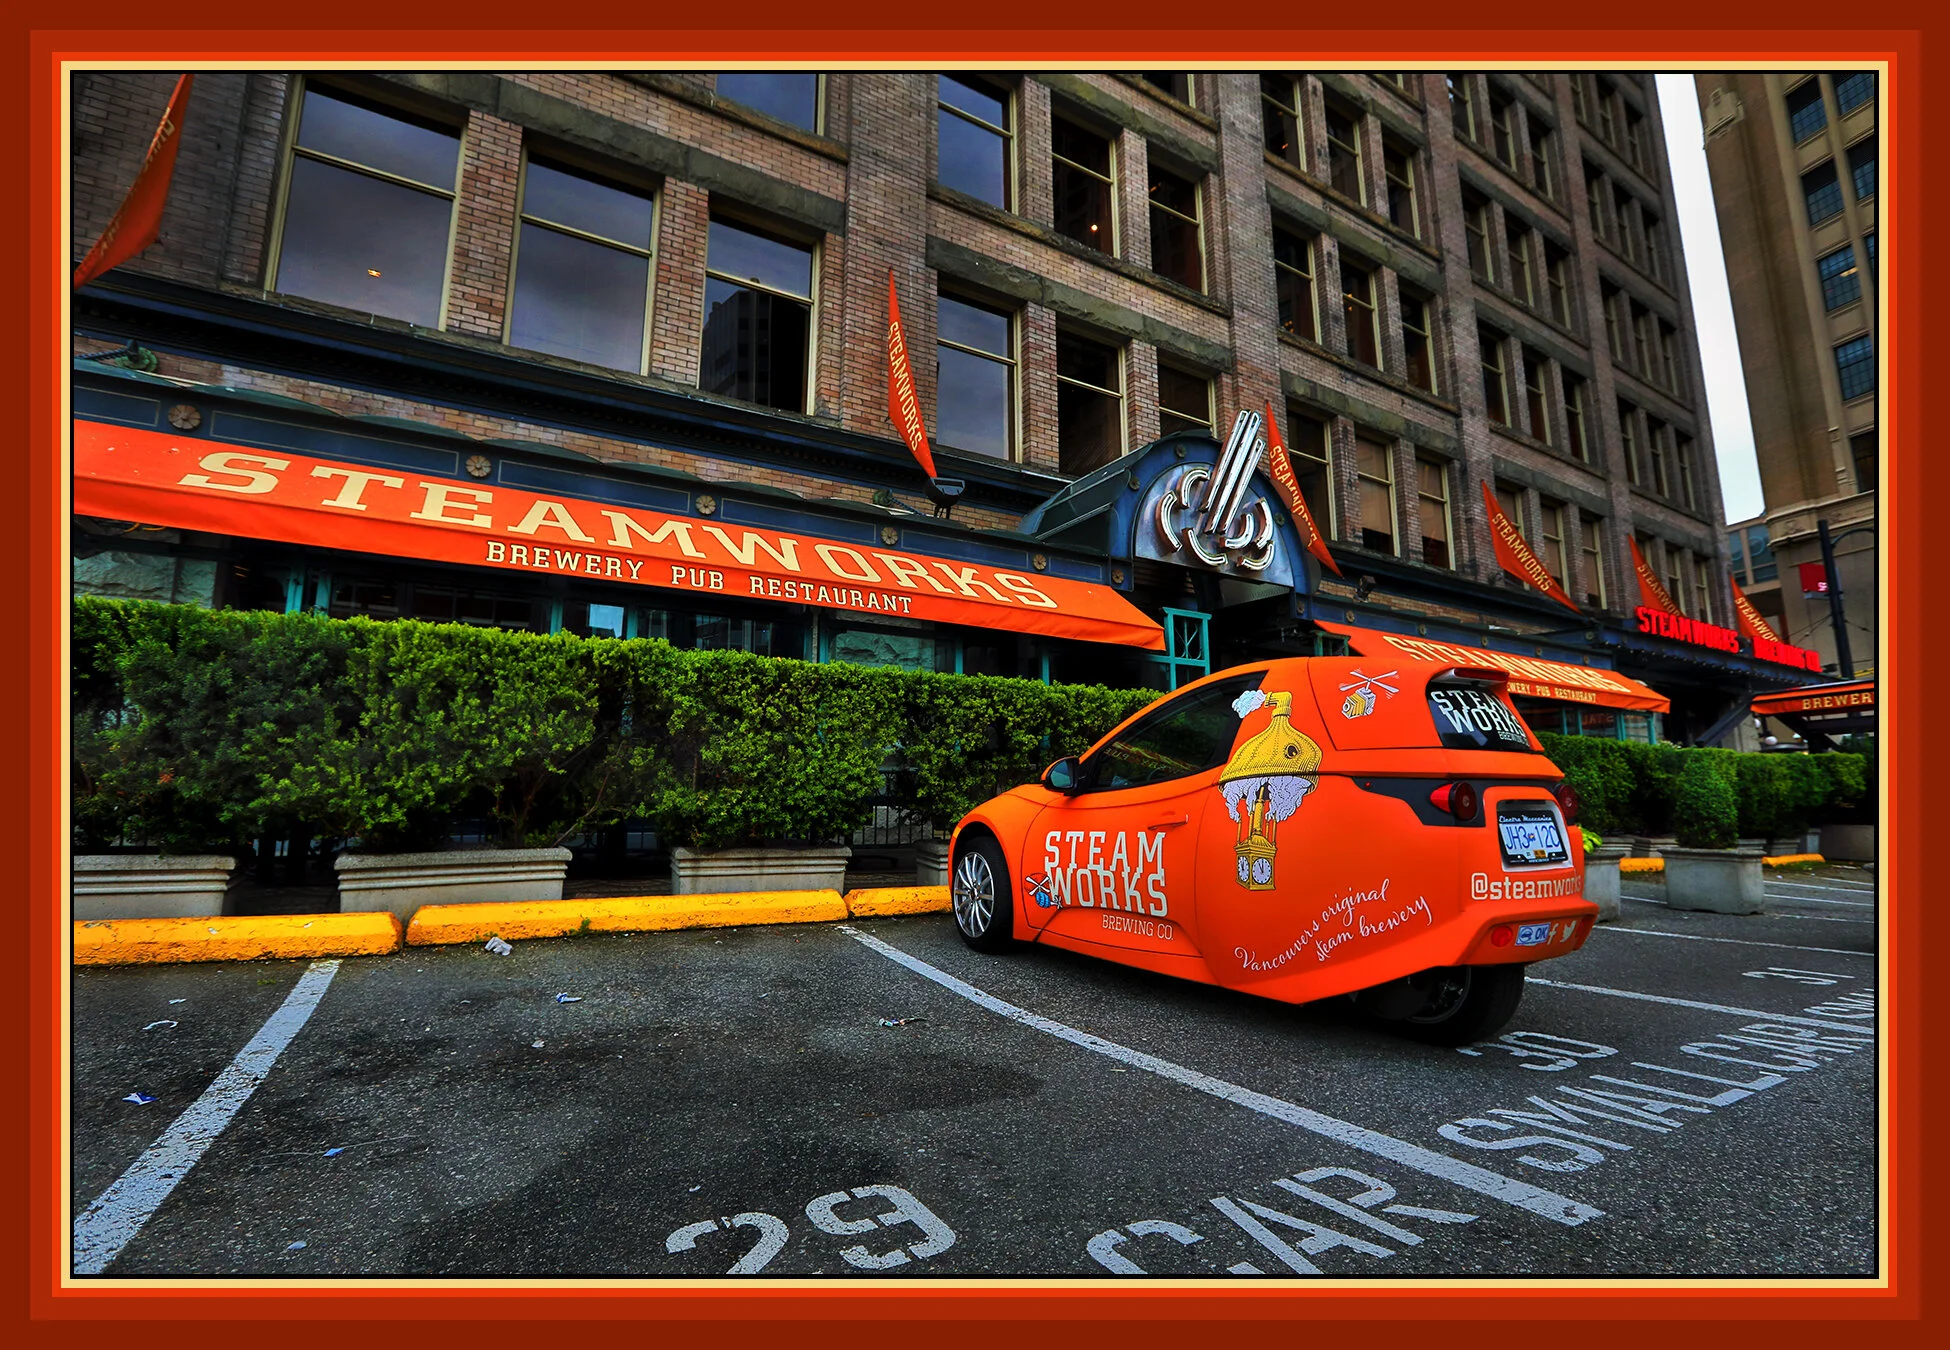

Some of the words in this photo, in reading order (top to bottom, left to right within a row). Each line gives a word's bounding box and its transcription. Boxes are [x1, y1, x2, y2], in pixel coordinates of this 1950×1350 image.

[887, 321, 923, 451] STEAMWORKS
[1269, 445, 1318, 547] STEAMWOS
[177, 451, 1058, 608] STEAMWORKS
[1492, 513, 1553, 591] STEAMWORKS
[486, 541, 645, 580] BREWERY
[671, 566, 725, 592] PUB
[750, 576, 912, 615] RESTAURANT
[1735, 596, 1779, 642] STEAMWO
[1383, 636, 1631, 692] STEAMWORKS
[1536, 685, 1551, 697] PUB
[1554, 687, 1597, 703] RESTAURANT
[1439, 704, 1527, 738] WORKS
[1044, 830, 1167, 873] STEAM
[1045, 866, 1168, 918] WORKS
[1471, 872, 1582, 900] @steamworks
[1102, 914, 1154, 937] BREWING
[1157, 923, 1174, 940] CO.
[1234, 919, 1320, 972] Vancouvers
[1321, 878, 1390, 927] original
[1316, 932, 1354, 962] steam
[1359, 896, 1433, 937] brewery
[1456, 1031, 1619, 1072] 30
[1437, 1062, 1790, 1173] SMALL
[665, 1184, 957, 1275] 29
[1087, 1165, 1481, 1275] CAR
